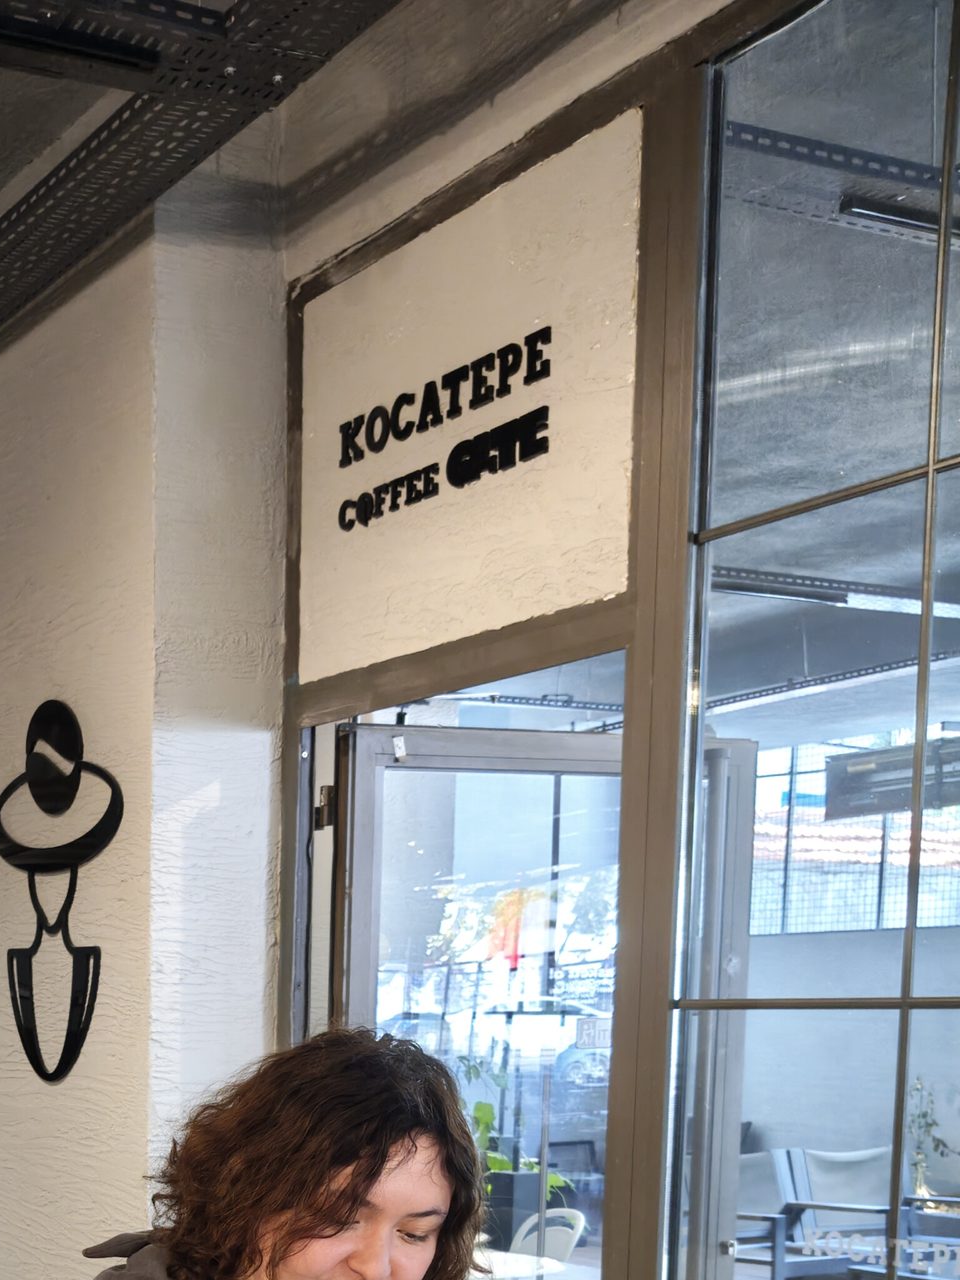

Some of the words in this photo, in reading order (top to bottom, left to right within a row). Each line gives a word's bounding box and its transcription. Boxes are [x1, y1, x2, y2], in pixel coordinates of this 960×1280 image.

[339, 326, 552, 468] KOCATEPE
[338, 462, 439, 532] COFFEE
[802, 1228, 960, 1277] KOCATEP
